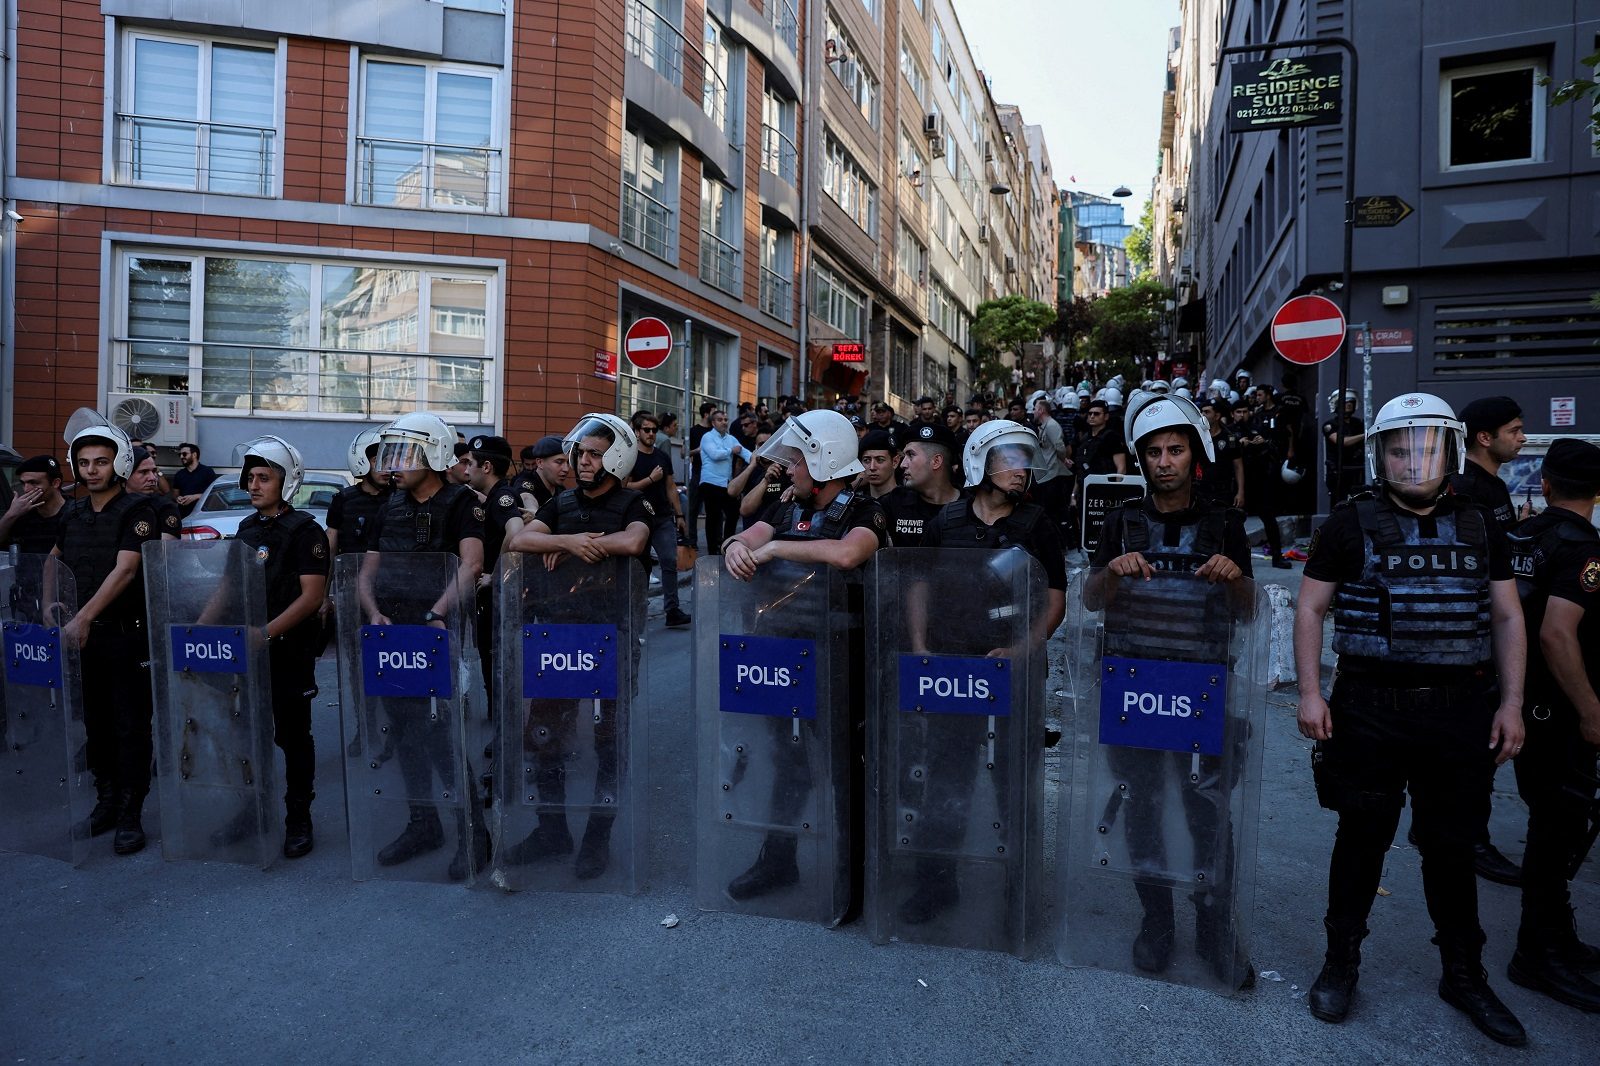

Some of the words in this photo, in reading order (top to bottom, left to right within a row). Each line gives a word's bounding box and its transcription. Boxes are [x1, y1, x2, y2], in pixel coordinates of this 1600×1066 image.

[1233, 75, 1340, 97] RESIDENCE
[1252, 90, 1319, 108] SUITES
[1236, 109, 1259, 118] 0212
[1260, 107, 1278, 116] 244
[1279, 106, 1291, 114] 22
[838, 344, 859, 352] SEFA
[833, 352, 862, 361] BÖREK
